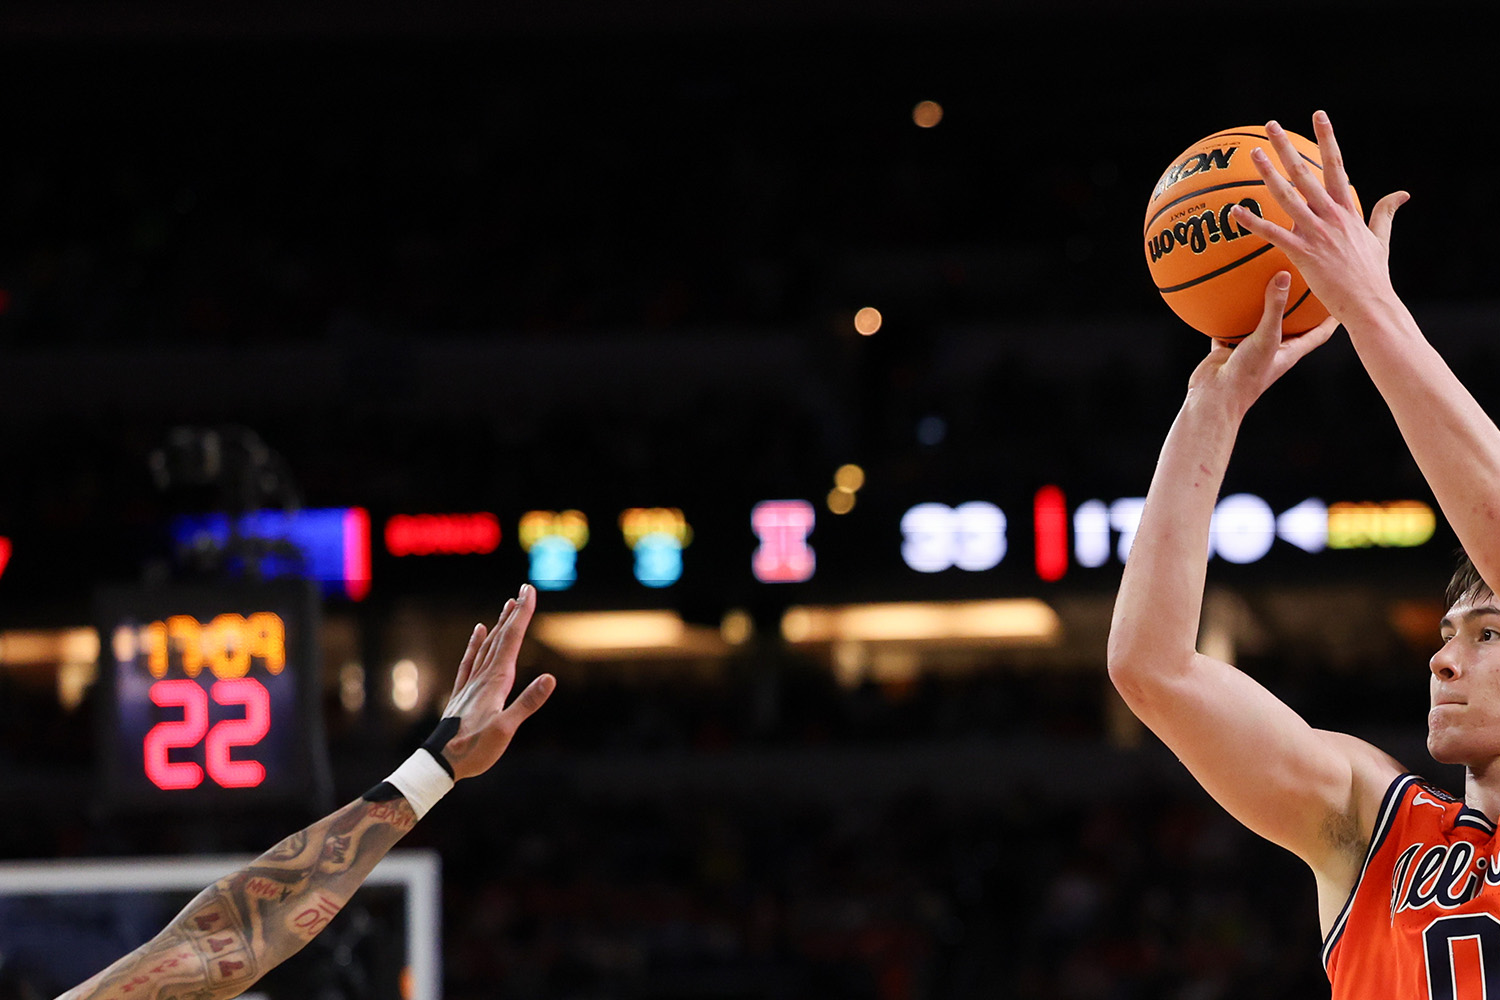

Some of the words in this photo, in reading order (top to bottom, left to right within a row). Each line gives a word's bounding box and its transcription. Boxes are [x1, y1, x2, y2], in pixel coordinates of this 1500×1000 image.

[1169, 210, 1187, 222] NXT
[1188, 202, 1207, 214] EVO
[1147, 198, 1264, 263] Wilson
[143, 677, 271, 791] 22
